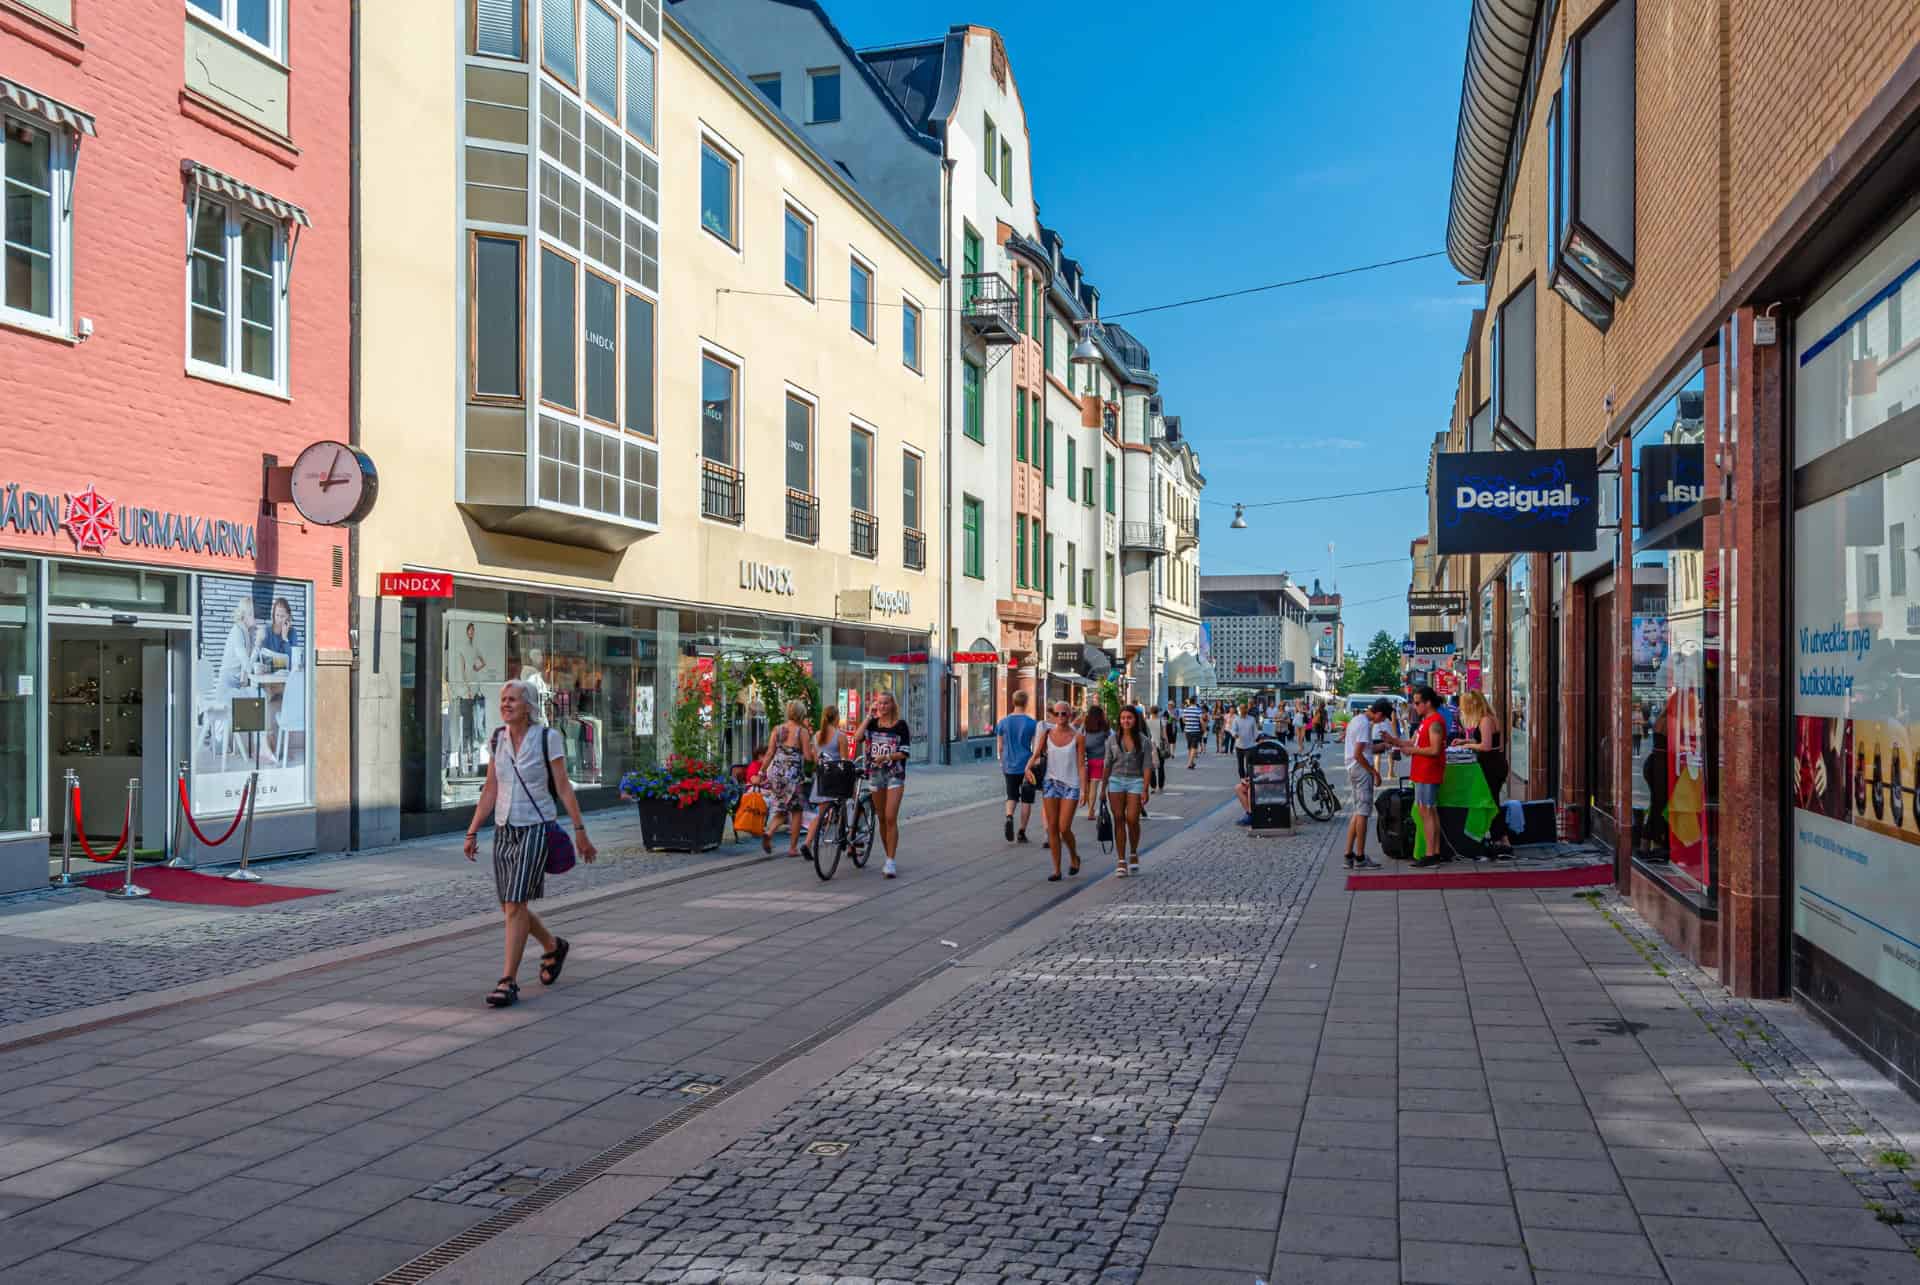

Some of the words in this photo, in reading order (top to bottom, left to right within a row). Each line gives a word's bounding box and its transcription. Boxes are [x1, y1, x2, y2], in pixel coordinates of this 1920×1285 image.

[585, 328, 615, 353] LINDEX
[118, 504, 258, 559] URMAKARNA
[384, 577, 441, 591] LINDEX
[739, 560, 795, 597] LINDEX
[1851, 626, 1871, 661] nya
[224, 786, 278, 798] SKEN
